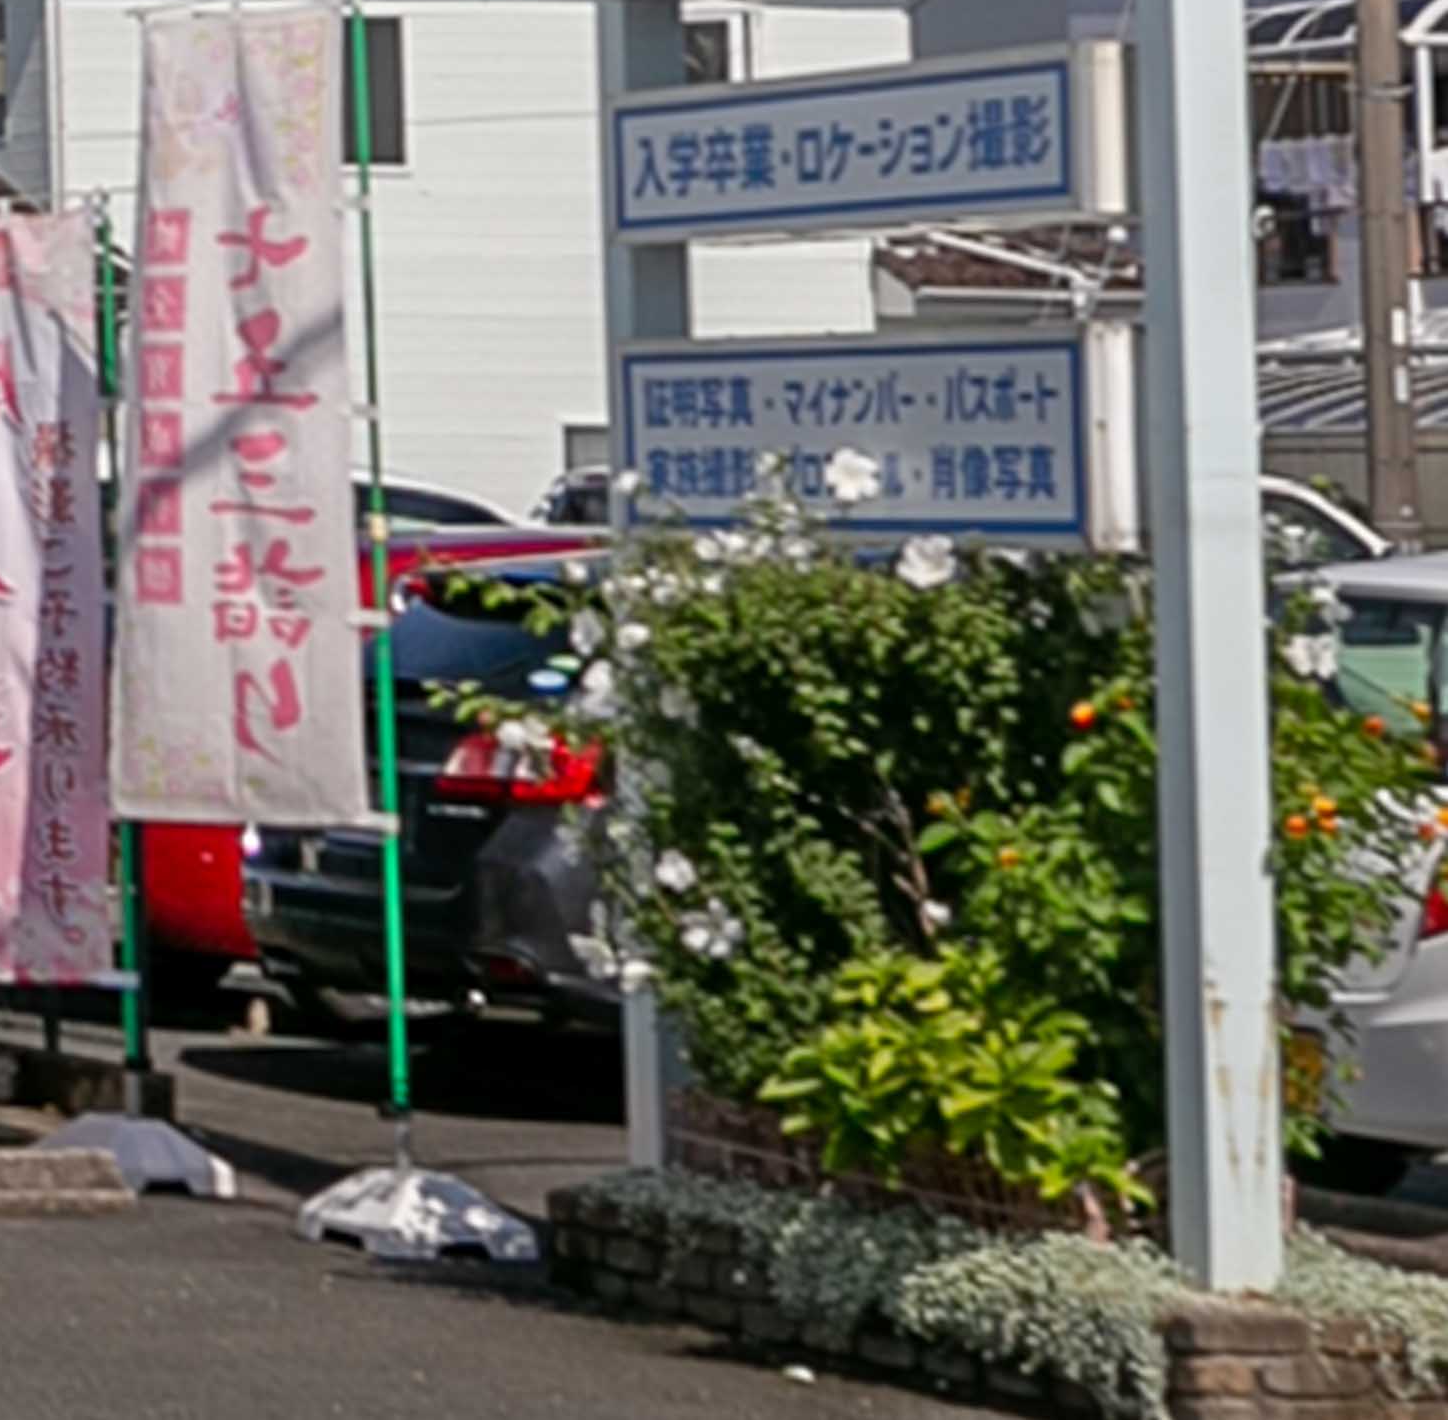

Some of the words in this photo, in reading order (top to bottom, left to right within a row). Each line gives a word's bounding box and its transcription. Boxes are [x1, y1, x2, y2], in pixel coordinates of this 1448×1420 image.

[634, 94, 1052, 198] 入学卒業・ロケーション撮影
